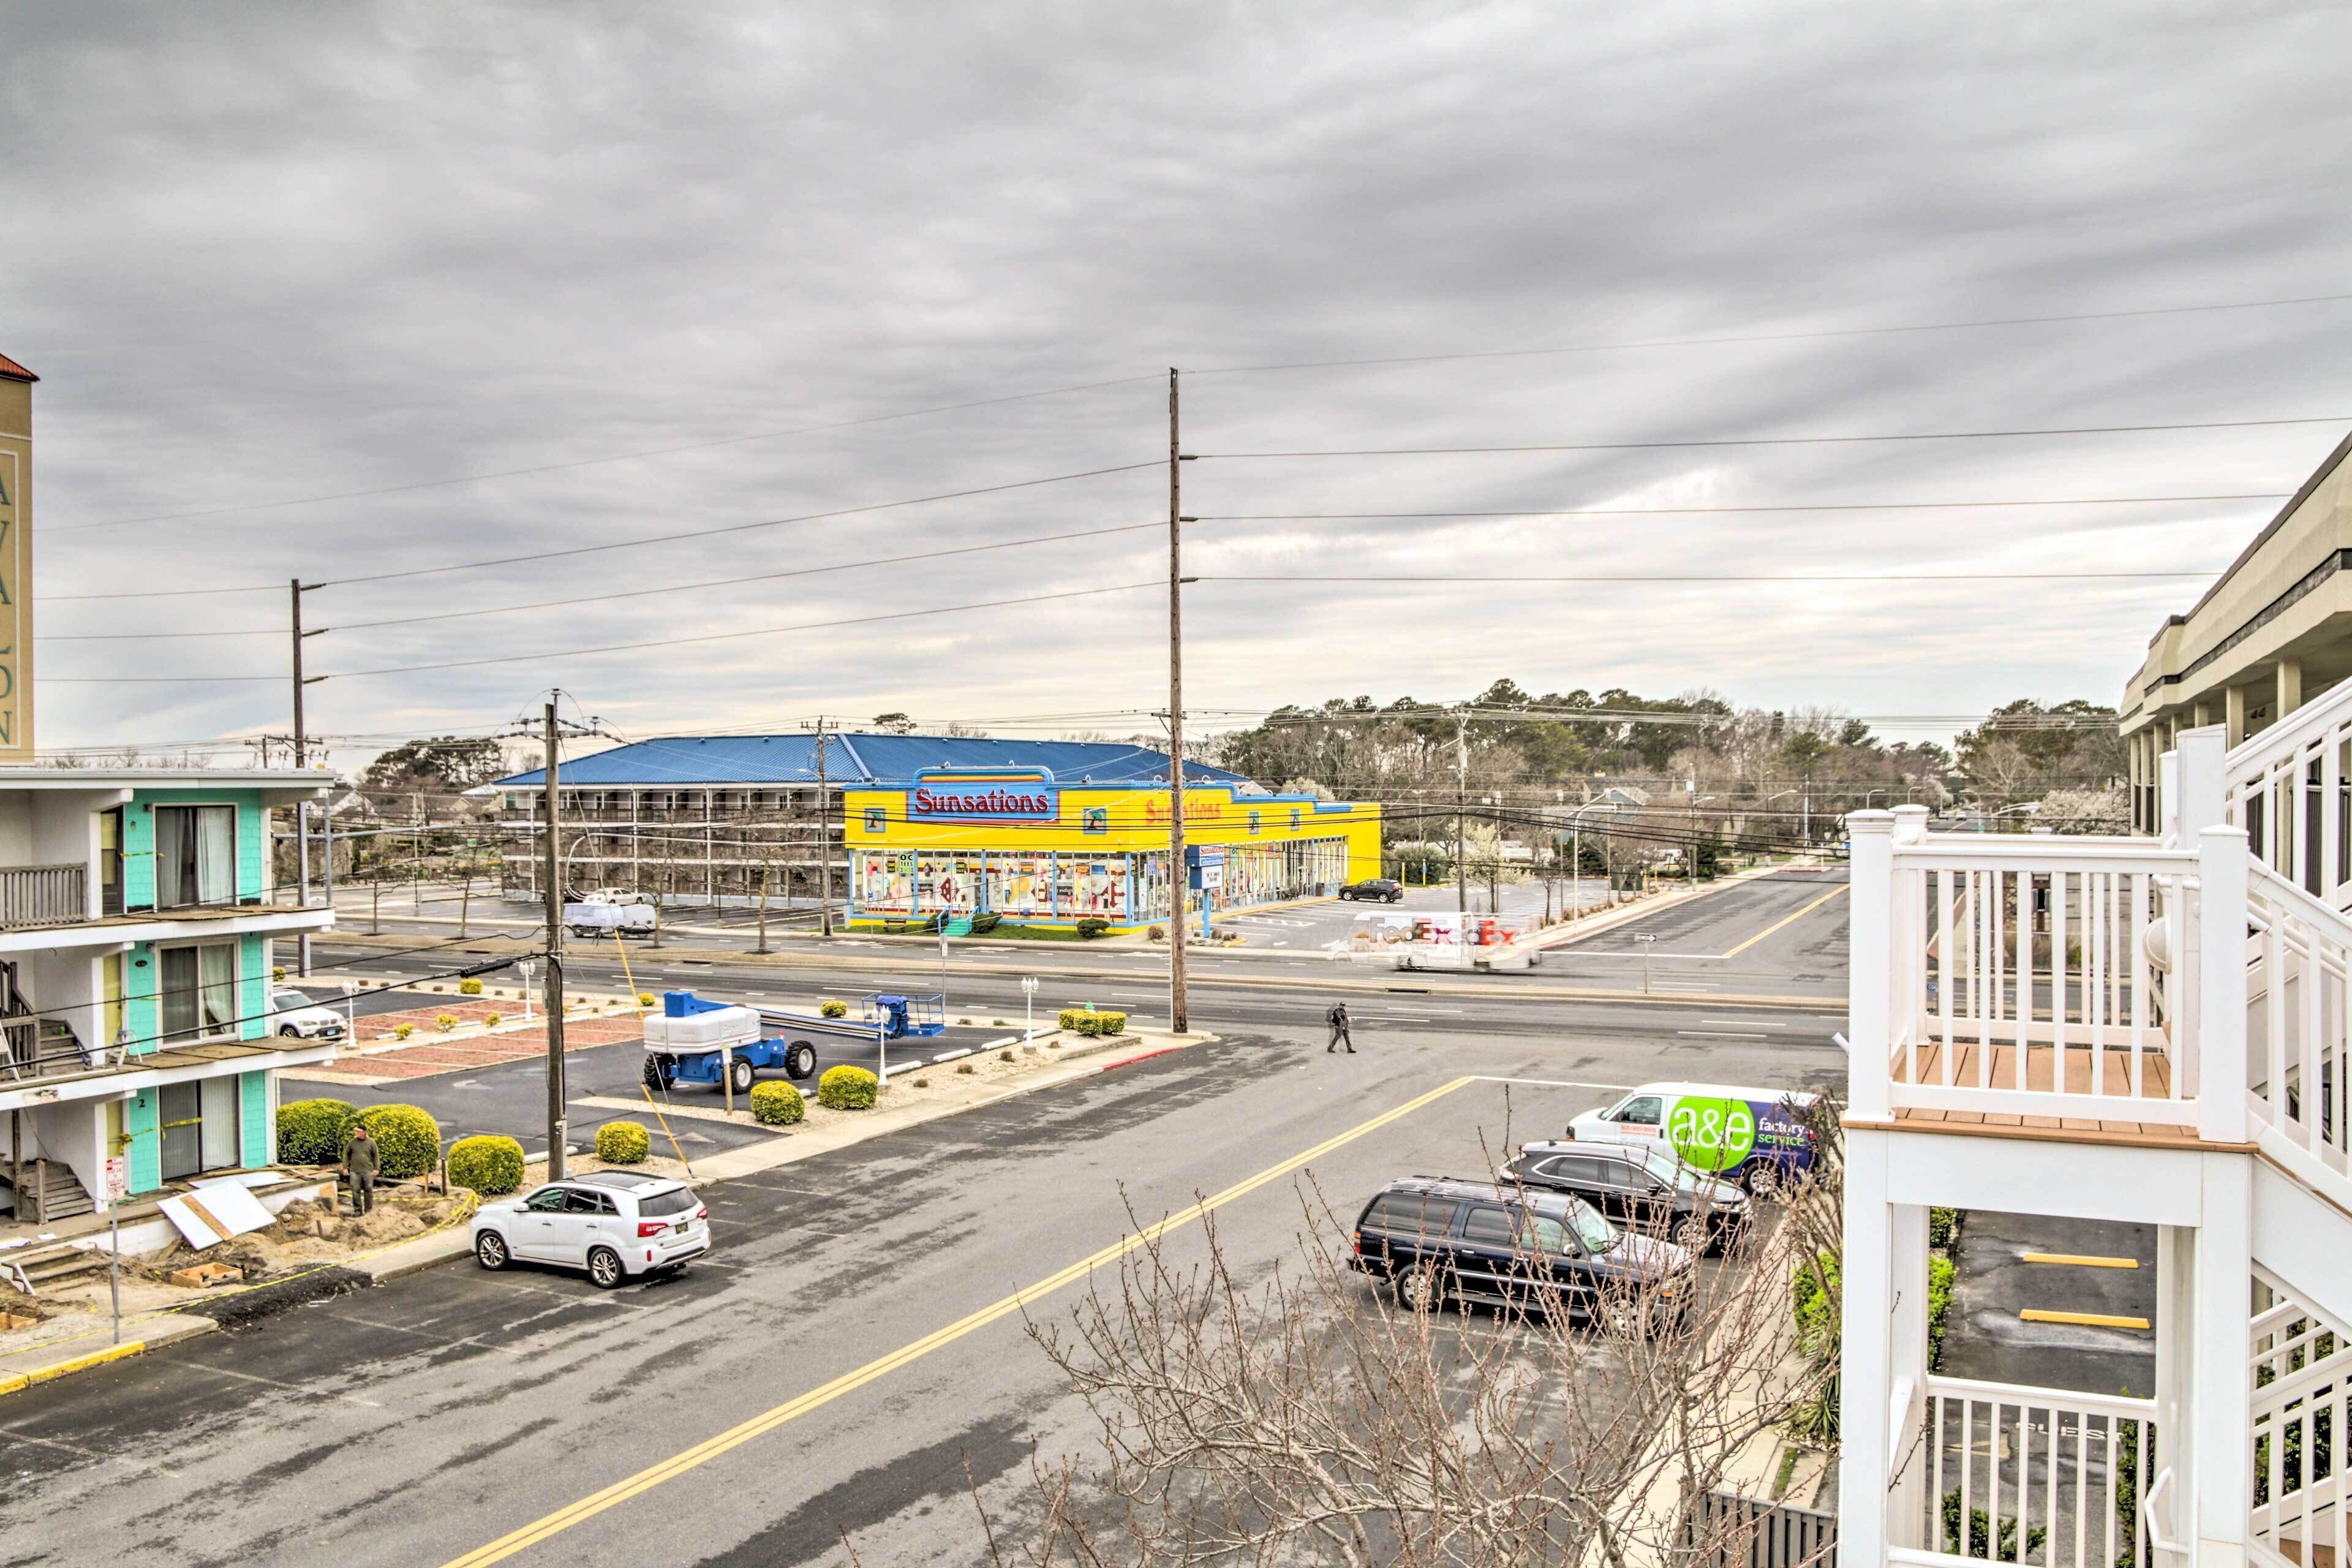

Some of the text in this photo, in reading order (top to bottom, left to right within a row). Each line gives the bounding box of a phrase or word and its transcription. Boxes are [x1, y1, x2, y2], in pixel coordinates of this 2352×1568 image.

[915, 788, 1049, 814] Sunsations
[1146, 798, 1221, 824] Sunations
[1370, 917, 1453, 945] FedEx
[138, 1098, 146, 1108] 2
[1672, 1107, 1751, 1152] a&e
[1758, 1117, 1806, 1138] factory
[1758, 1133, 1805, 1147] service
